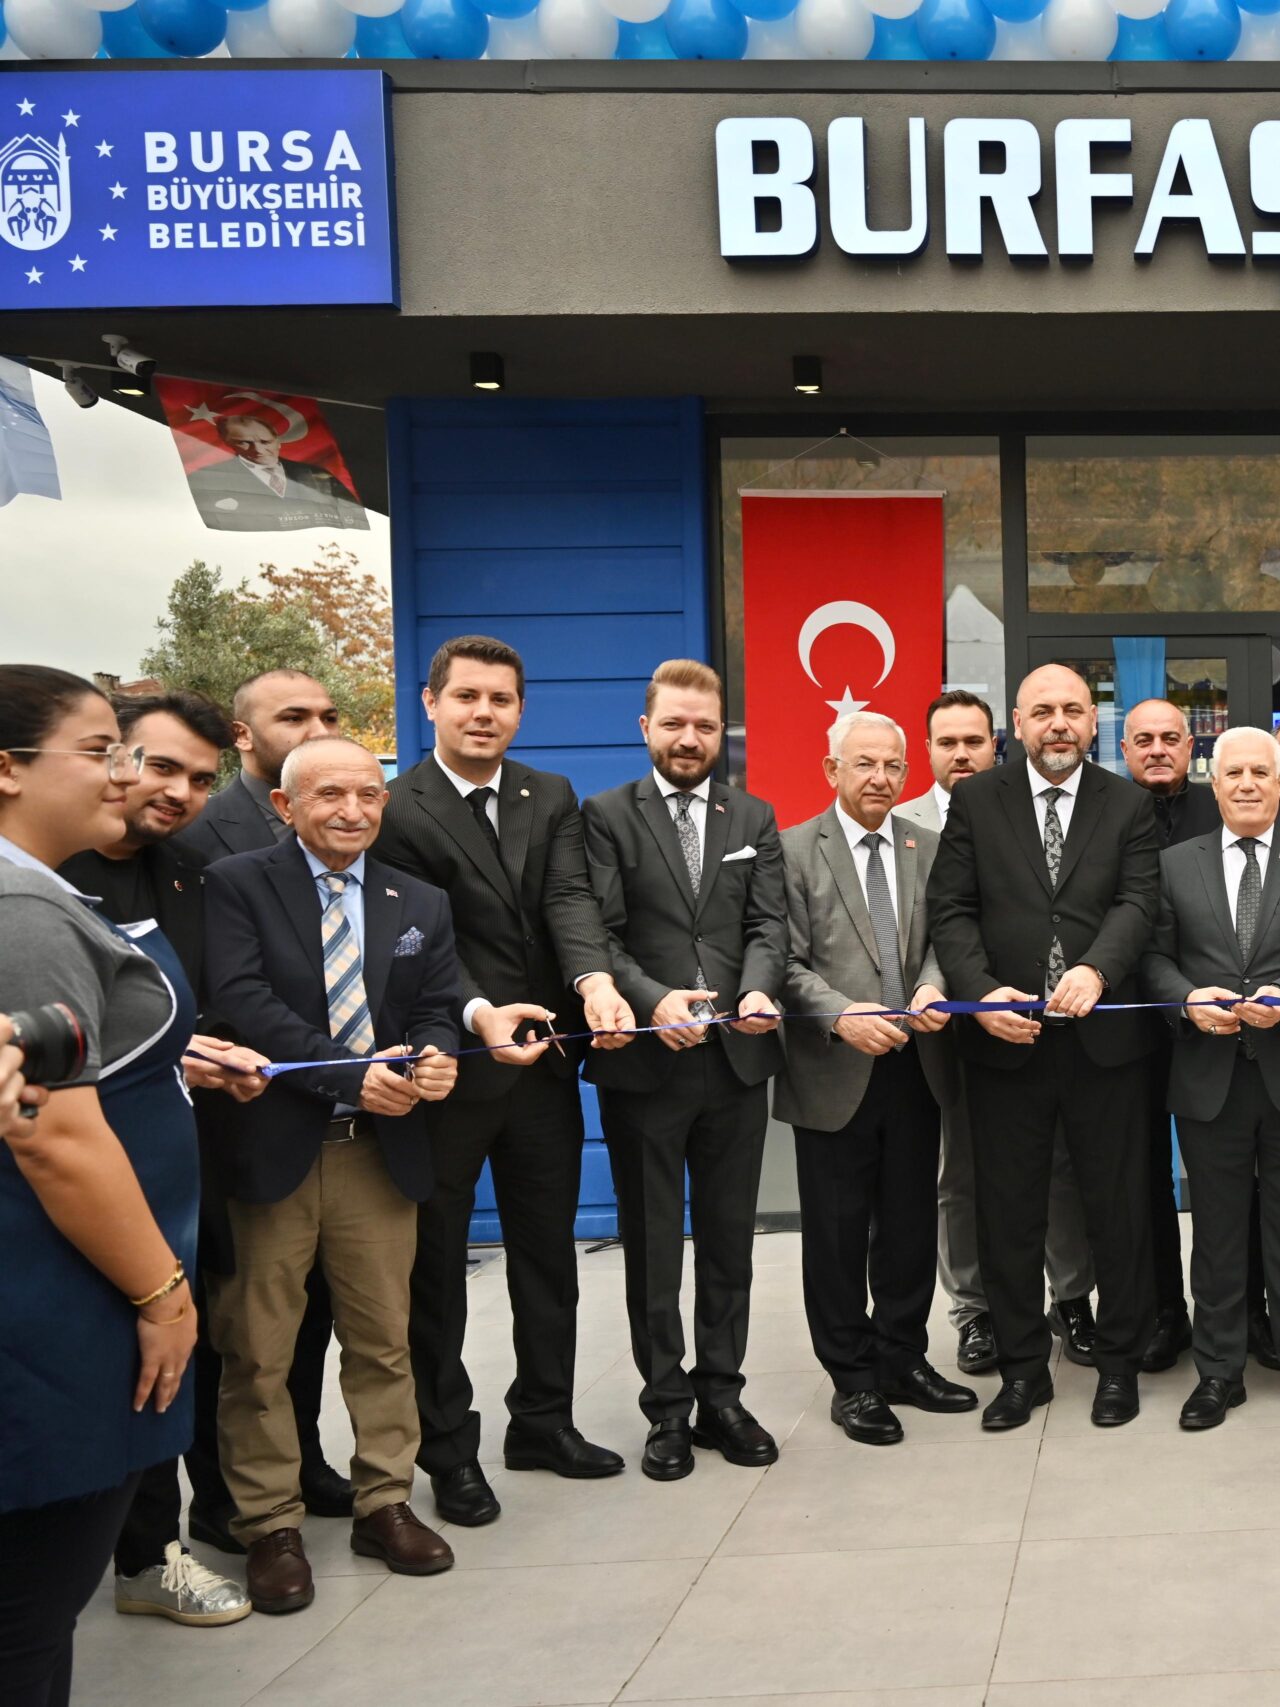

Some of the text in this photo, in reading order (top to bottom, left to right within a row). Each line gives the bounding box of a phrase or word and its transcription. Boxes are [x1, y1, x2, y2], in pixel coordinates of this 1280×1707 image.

[144, 129, 362, 173] BURSA
[146, 174, 363, 214] BÜYÜKŞEHİR
[149, 212, 366, 249] BELEDİYESİ
